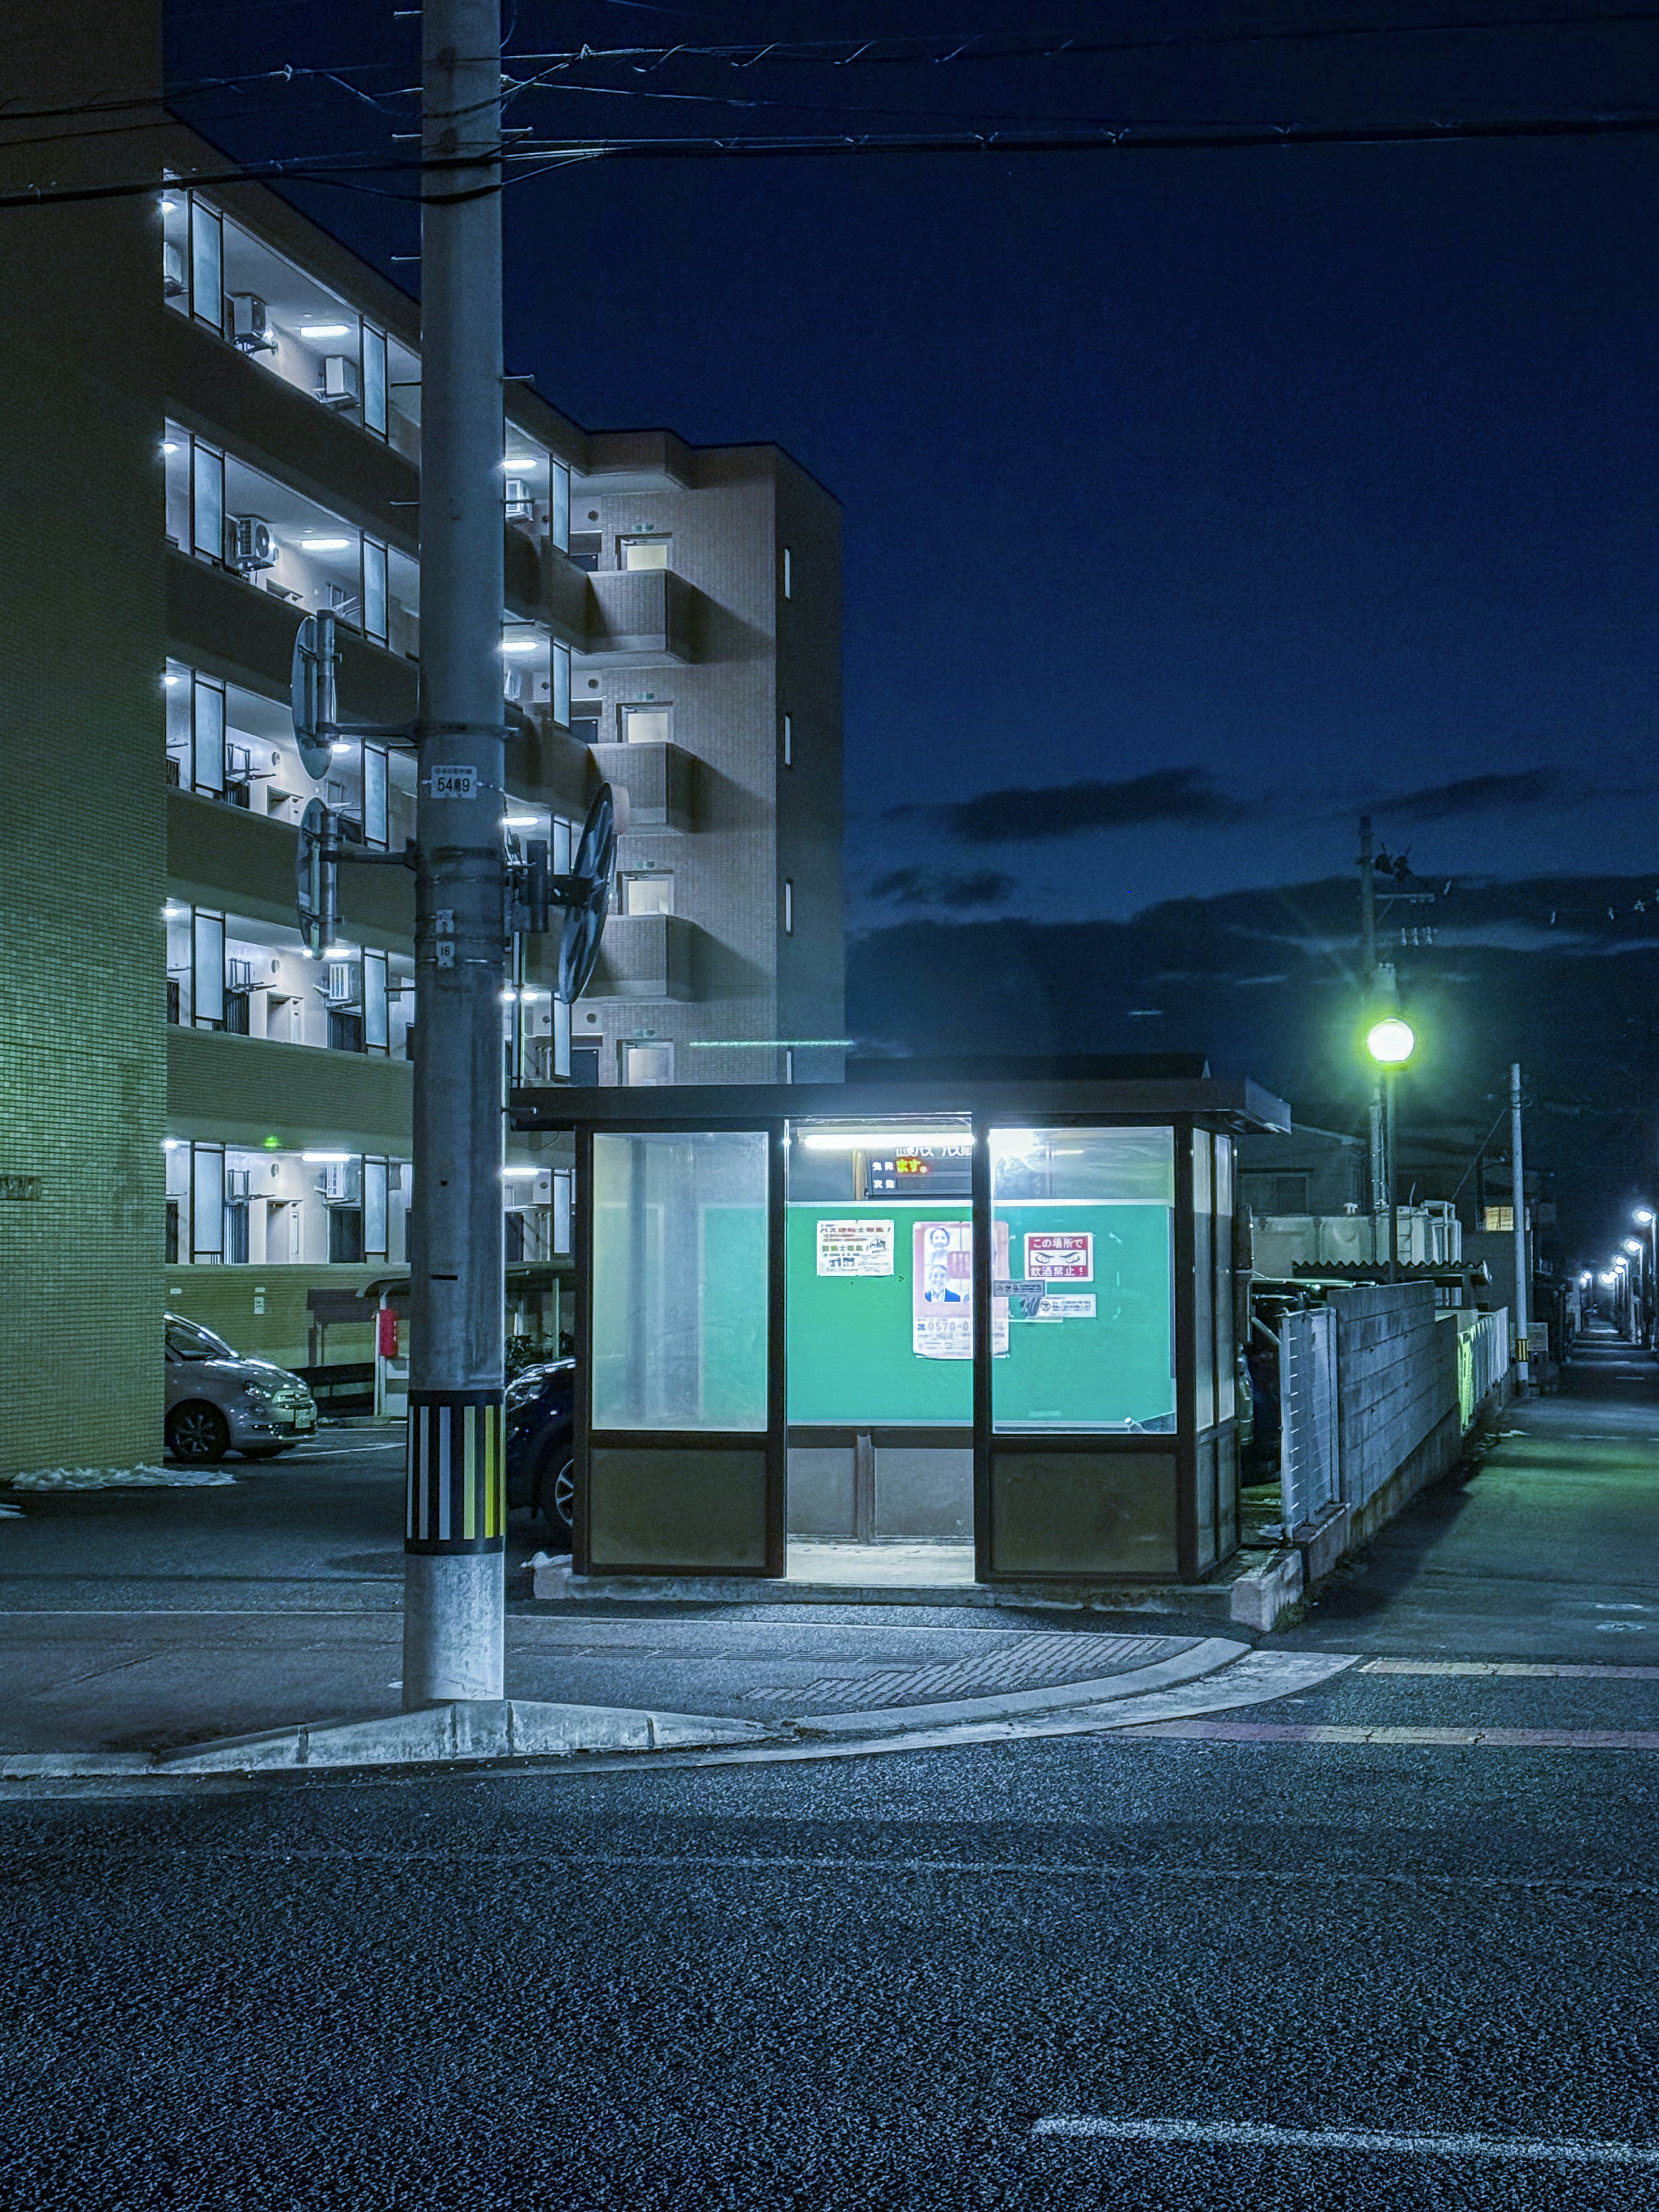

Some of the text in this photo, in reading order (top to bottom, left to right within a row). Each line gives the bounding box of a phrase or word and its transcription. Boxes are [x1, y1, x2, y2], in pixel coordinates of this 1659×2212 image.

[1033, 1238, 1084, 1249] この場所で
